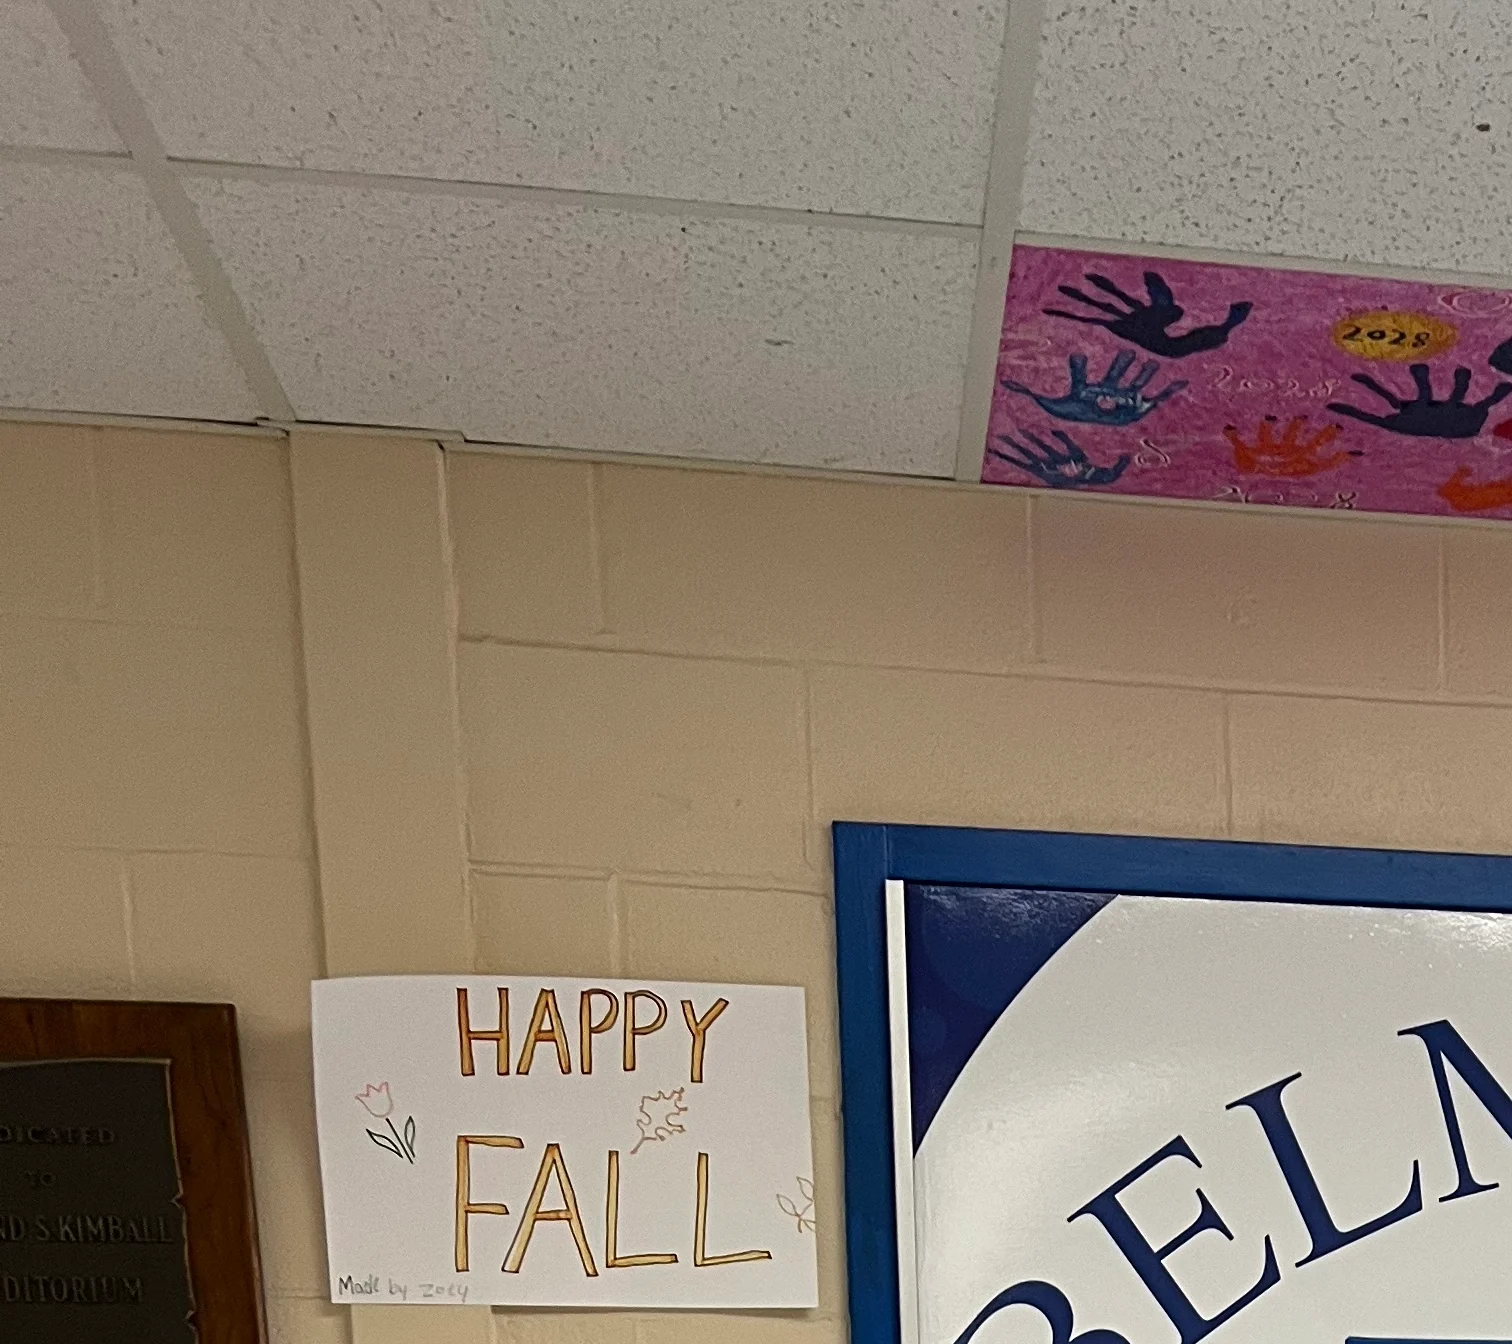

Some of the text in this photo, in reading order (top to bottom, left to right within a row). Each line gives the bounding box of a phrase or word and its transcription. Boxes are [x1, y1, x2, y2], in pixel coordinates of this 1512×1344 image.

[1342, 324, 1431, 348] 2028
[456, 986, 729, 1083] HAPPY
[454, 1135, 773, 1277] FALL
[58, 1214, 175, 1243] KIMBALL
[339, 1274, 379, 1295] Made
[389, 1278, 407, 1301] by
